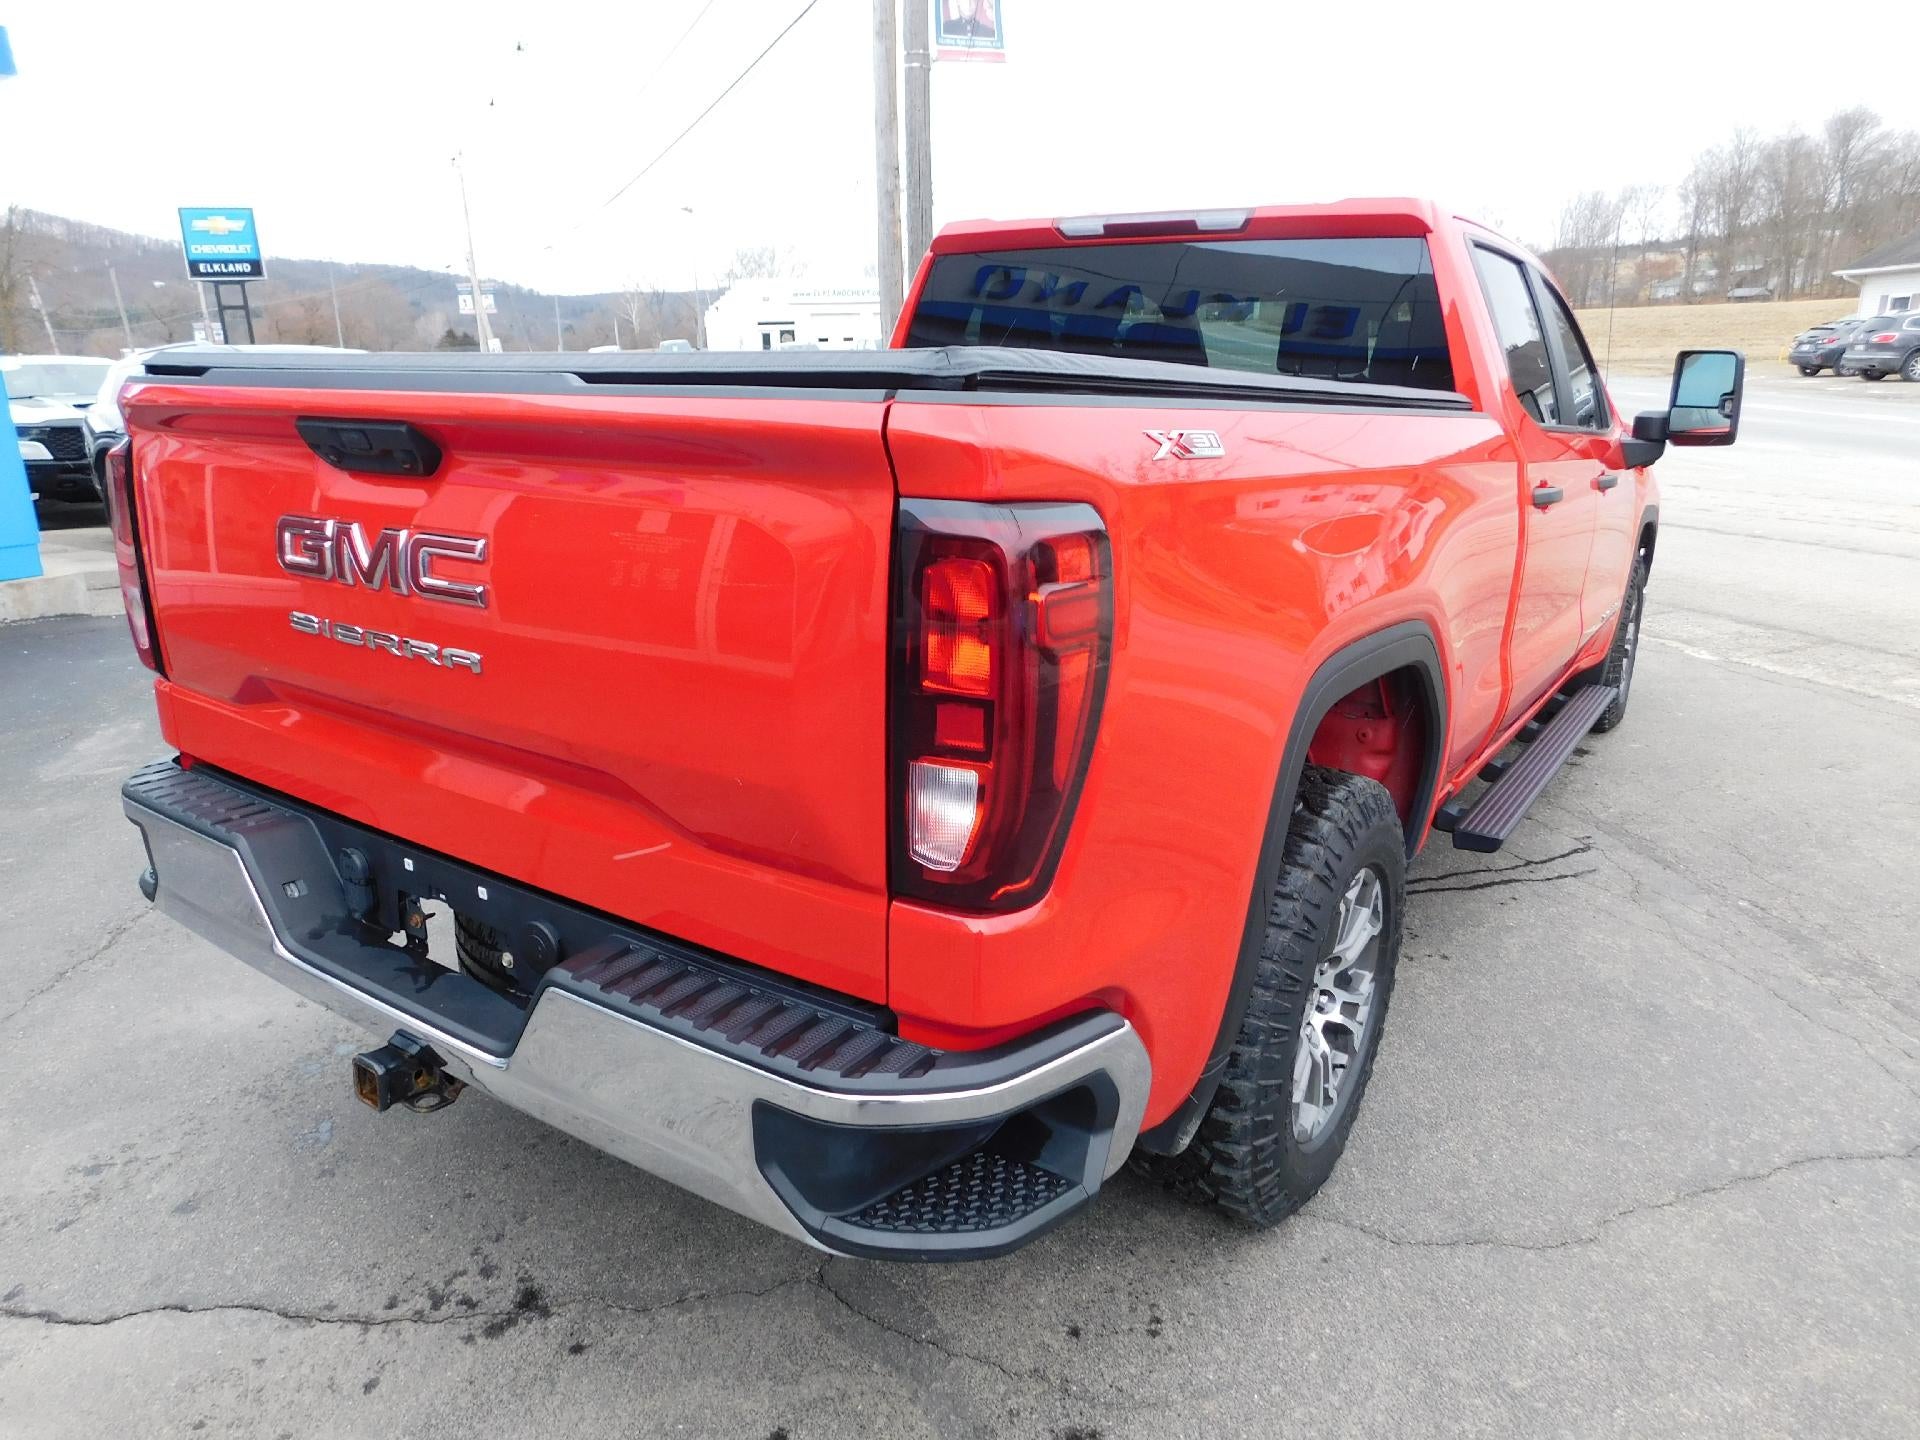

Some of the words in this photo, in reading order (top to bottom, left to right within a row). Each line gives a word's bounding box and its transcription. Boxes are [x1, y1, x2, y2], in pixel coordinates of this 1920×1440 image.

[191, 244, 252, 254] CHEVROLET
[199, 263, 251, 273] ELKLAND
[276, 514, 488, 608] GMC
[289, 610, 482, 674] SIERRA
